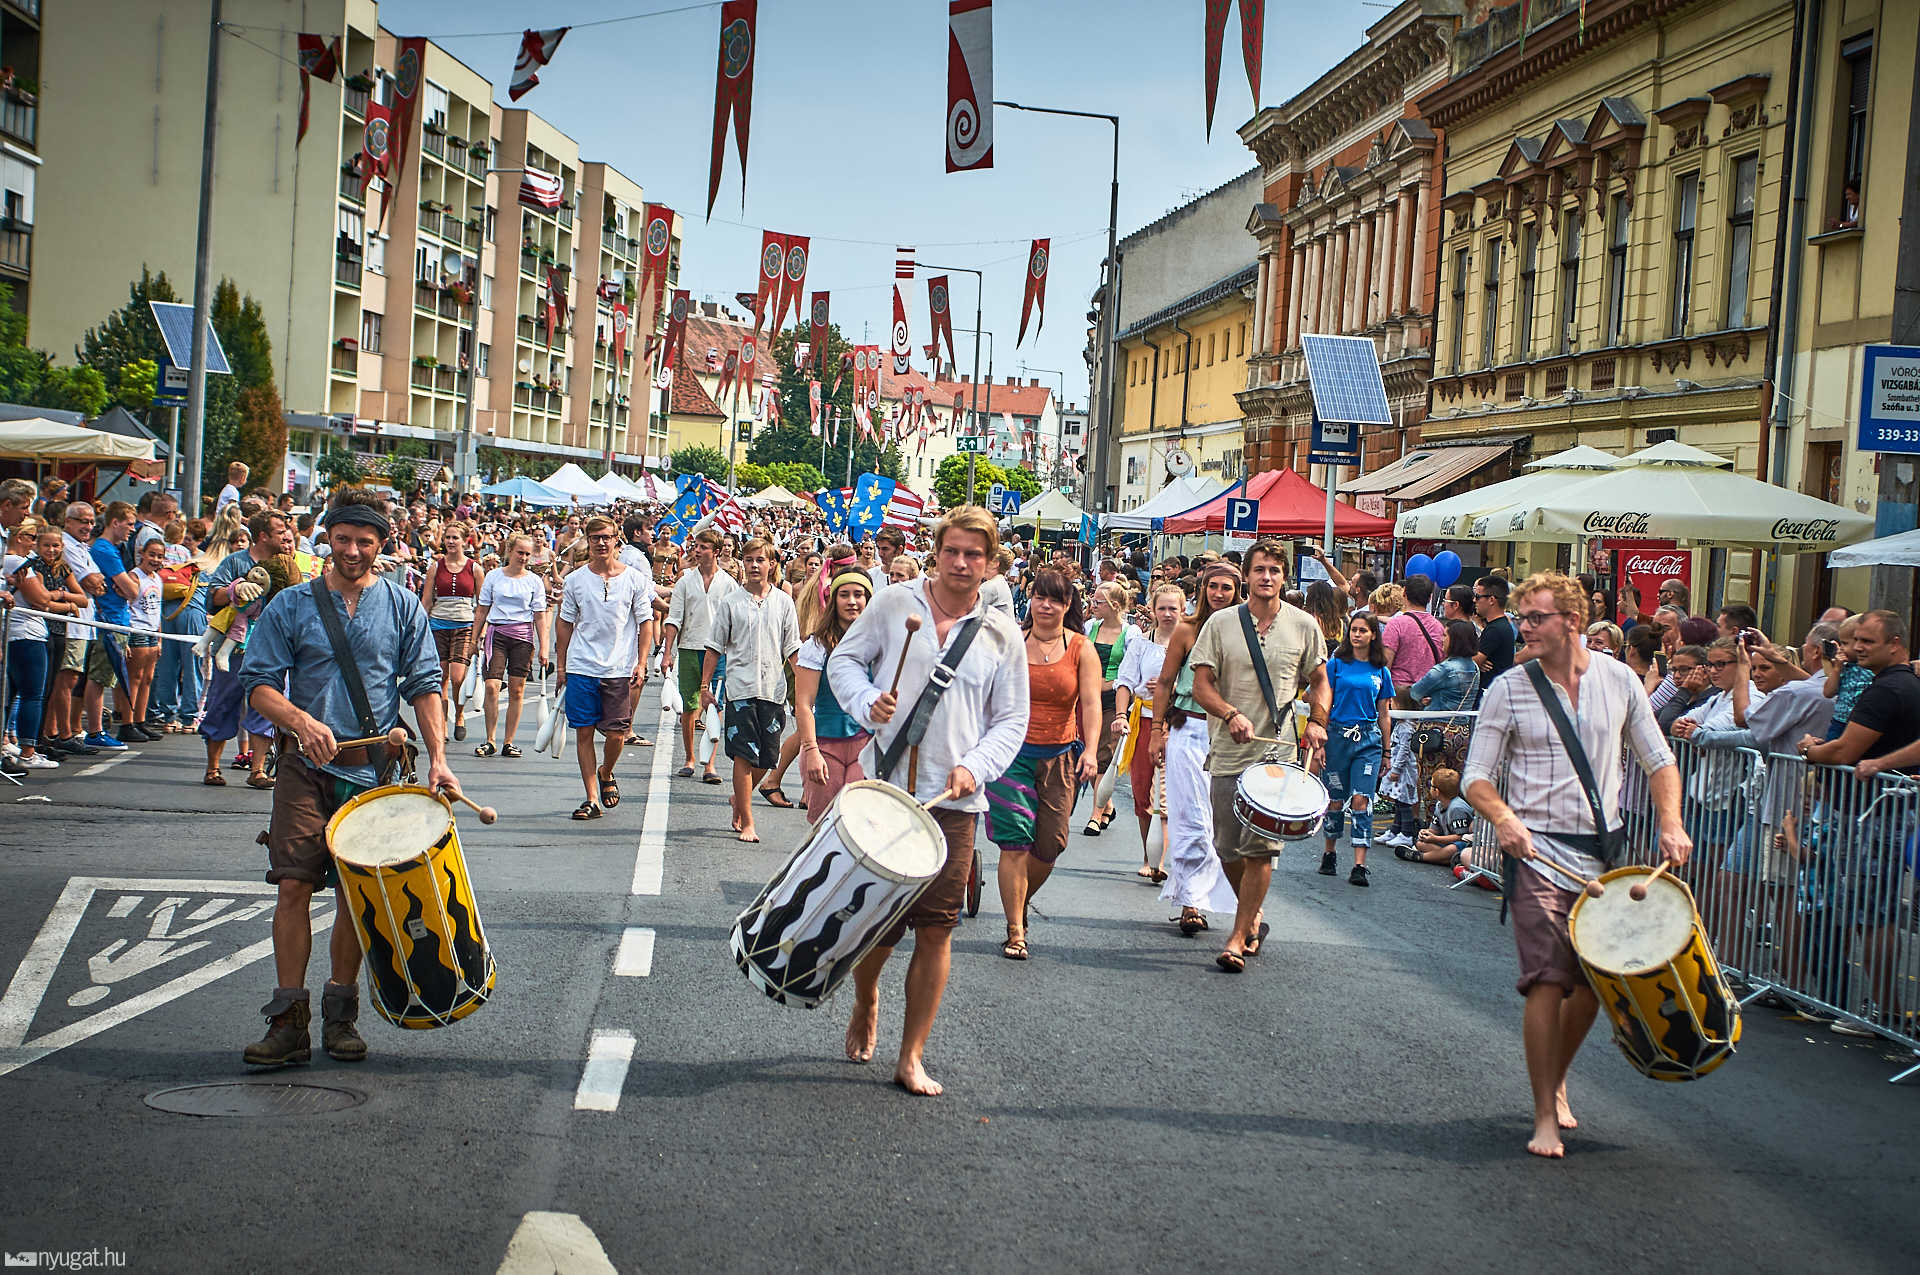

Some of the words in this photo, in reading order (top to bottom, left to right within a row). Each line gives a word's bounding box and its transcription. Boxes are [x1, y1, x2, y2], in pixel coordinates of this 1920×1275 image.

[1881, 379, 1920, 391] VIZSGABÁ
[1882, 402, 1905, 411] Szófia
[1878, 428, 1920, 442] 339-33
[1233, 501, 1251, 528] P
[1584, 511, 1651, 534] Coca-Cola
[1771, 518, 1840, 541] Coca-Cola
[1626, 554, 1686, 575] Coca-Cola
[1453, 819, 1467, 829] NYC
